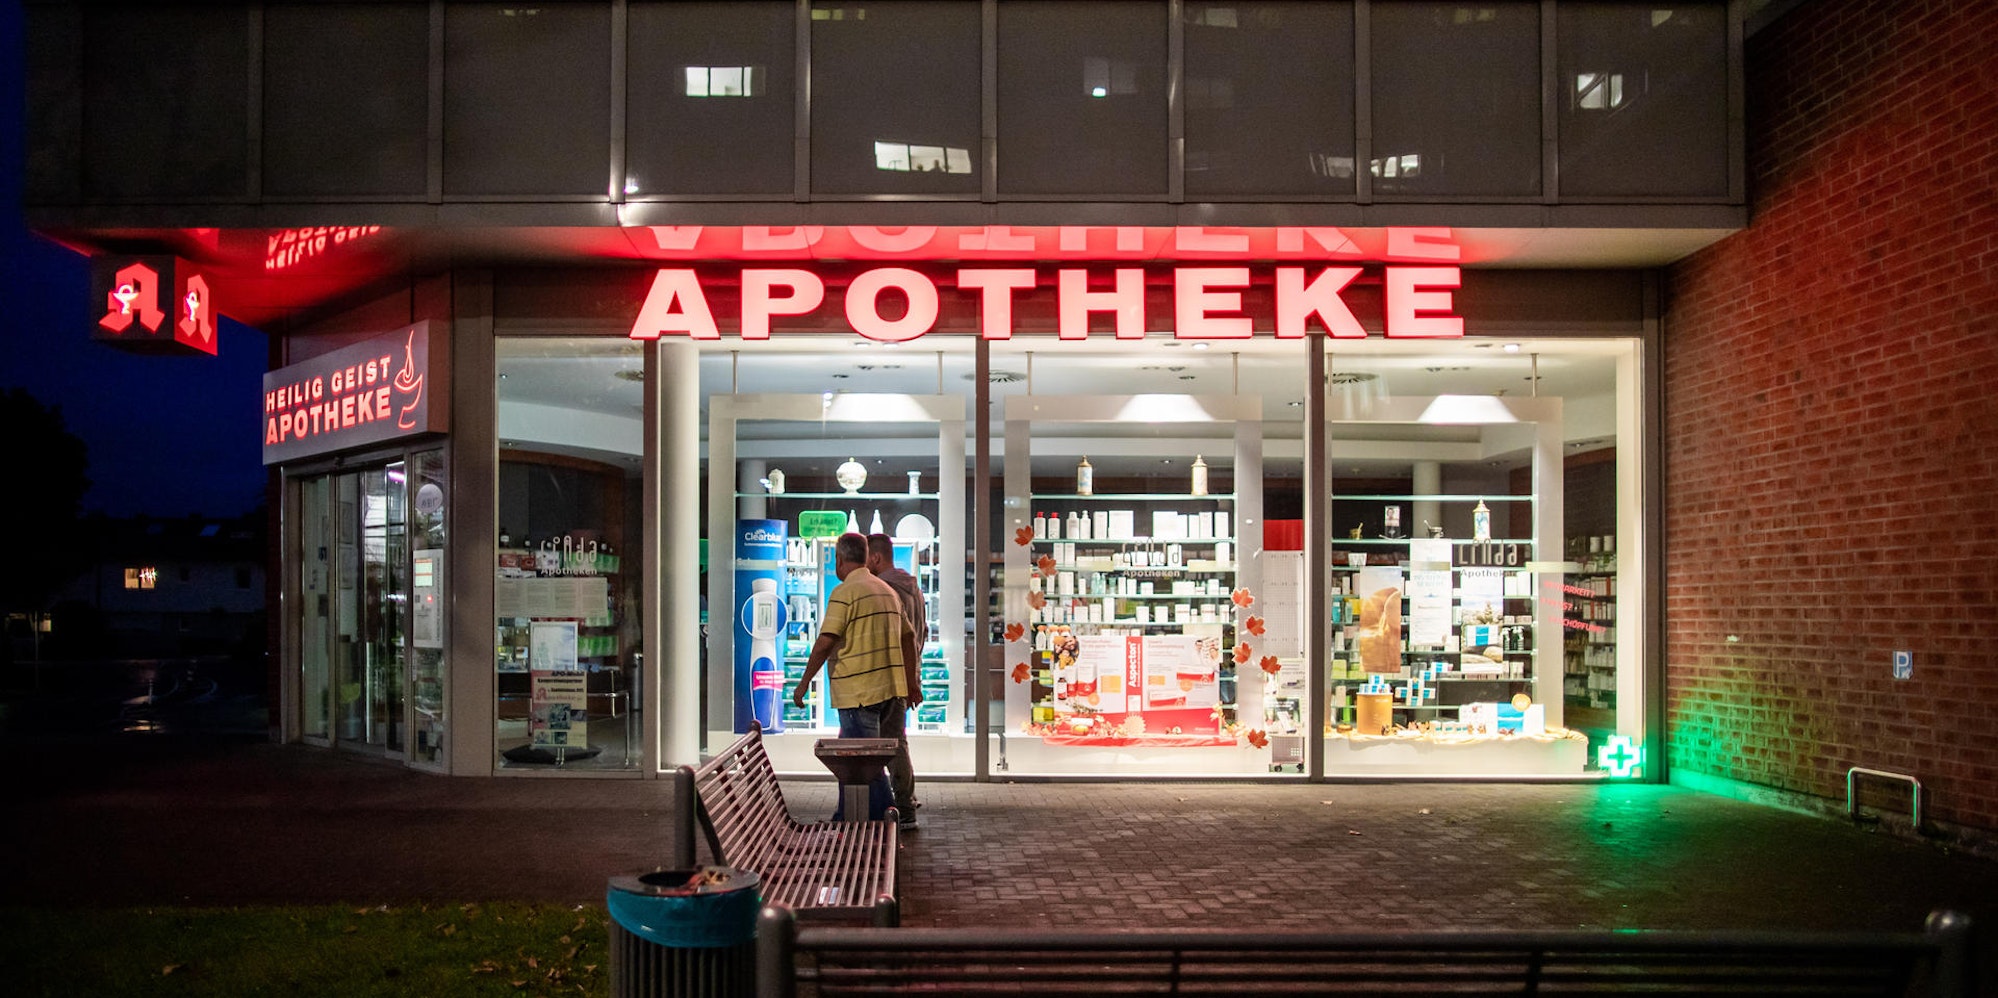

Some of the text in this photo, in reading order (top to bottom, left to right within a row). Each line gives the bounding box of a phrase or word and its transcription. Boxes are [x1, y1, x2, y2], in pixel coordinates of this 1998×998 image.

[630, 267, 1465, 341] APOTHEKE
[265, 355, 391, 413] HEILIG GEIST
[265, 386, 391, 445] APOTHEKE
[1122, 570, 1181, 578] Apotheken
[1128, 642, 1138, 688] Aspecton
[1896, 651, 1909, 678] P
